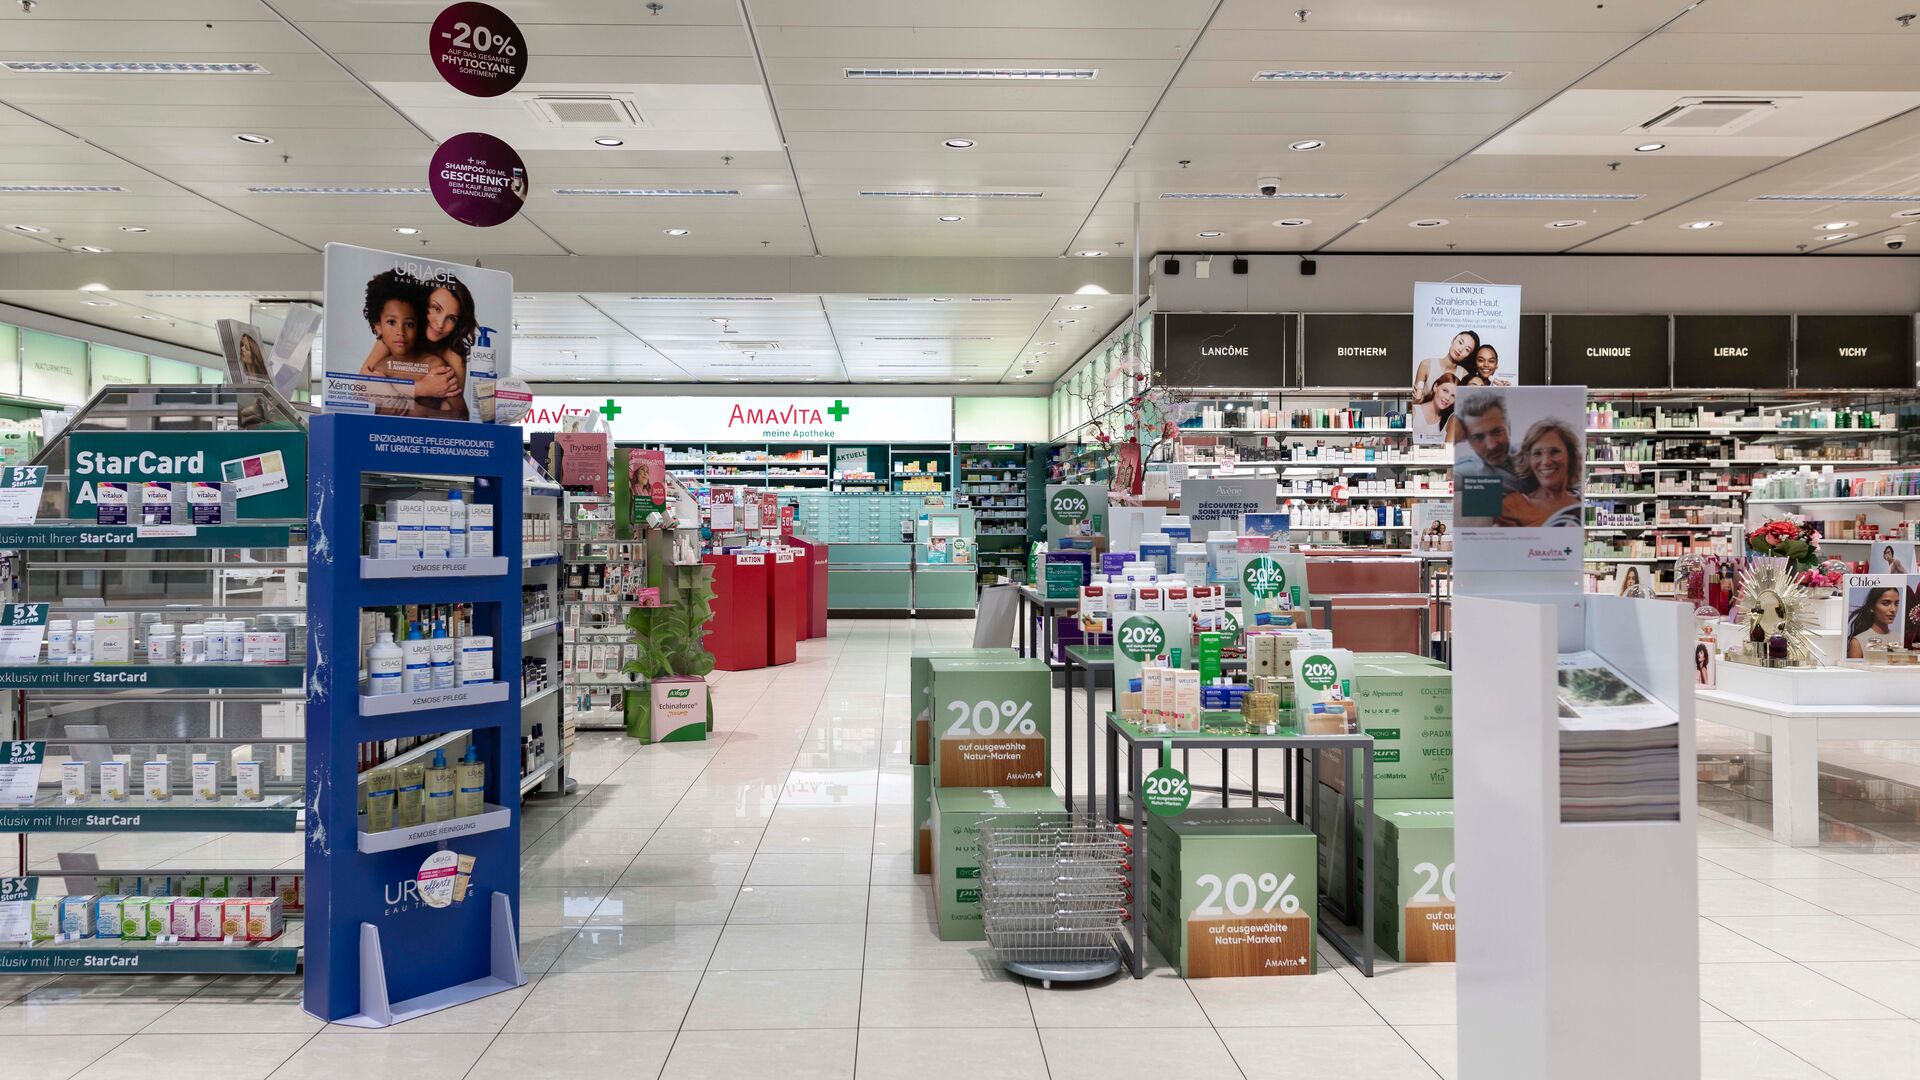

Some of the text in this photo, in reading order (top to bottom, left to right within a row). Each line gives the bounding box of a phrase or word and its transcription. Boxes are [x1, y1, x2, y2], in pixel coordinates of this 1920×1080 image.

[442, 22, 516, 56] -20%
[448, 48, 509, 64] AUF DAS GESAMTE
[442, 55, 515, 74] PHYTOCYANE
[459, 67, 498, 78] SORTIMENT
[446, 162, 484, 173] SHAMPOO
[441, 170, 510, 187] GESCHENKT
[448, 182, 502, 194] BEIM KAUF EINER
[394, 260, 456, 283] URIAGE
[416, 280, 456, 290] THERMALE
[1435, 297, 1477, 306] Strahlende
[1432, 306, 1443, 315] Mit
[1202, 345, 1248, 356] LANCÔME
[1338, 347, 1386, 356] BIOTHERM
[1587, 347, 1631, 357] CLINIQUE
[1714, 348, 1748, 357] LIERAC
[1839, 347, 1867, 357] VICHY
[35, 362, 72, 376] NATURMITTEL
[328, 379, 367, 392] Xémose
[793, 429, 835, 438] Apotheke
[370, 434, 494, 448] EINZIGARTIGE PFLEGEPRODUKTE
[391, 444, 420, 454] URIAGE
[422, 446, 488, 457] THERMALWASSER
[836, 450, 866, 462] AKTUELL
[76, 450, 204, 475] StarCard
[12, 479, 37, 488] Sterne
[1216, 486, 1242, 495] Avène
[712, 492, 733, 504] -20%
[1054, 498, 1086, 510] 20%
[28, 533, 46, 543] mit
[50, 533, 77, 543] Ihrer
[80, 532, 134, 544] StarCard
[1247, 568, 1282, 582] 20%
[1850, 576, 1880, 587] Chloé
[12, 617, 38, 625] Sterne
[1122, 627, 1162, 643] 20%
[1305, 664, 1334, 676] 20%
[42, 672, 59, 682] mit
[63, 672, 90, 682] Ihrer
[93, 671, 147, 683] StarCard
[413, 694, 468, 705] XÉMOSE PFLEGE
[947, 700, 1036, 736] 20%
[974, 743, 1026, 752] ausgewählte
[10, 755, 36, 764] Sterne
[1147, 777, 1188, 796] 20%
[34, 816, 51, 826] mit
[56, 815, 84, 826] Ihrer
[86, 815, 140, 826] StarCard
[408, 822, 476, 840] XÉMOSE REINIGUNG
[1, 891, 28, 901] Sterne
[1195, 873, 1300, 916] 20%
[385, 905, 408, 916] EAU
[1209, 923, 1287, 934] auf ausgewählte
[1216, 936, 1281, 945] Natur-Marken
[31, 956, 51, 966] mit
[54, 956, 81, 966] Ihrer
[84, 956, 138, 966] StarCard
